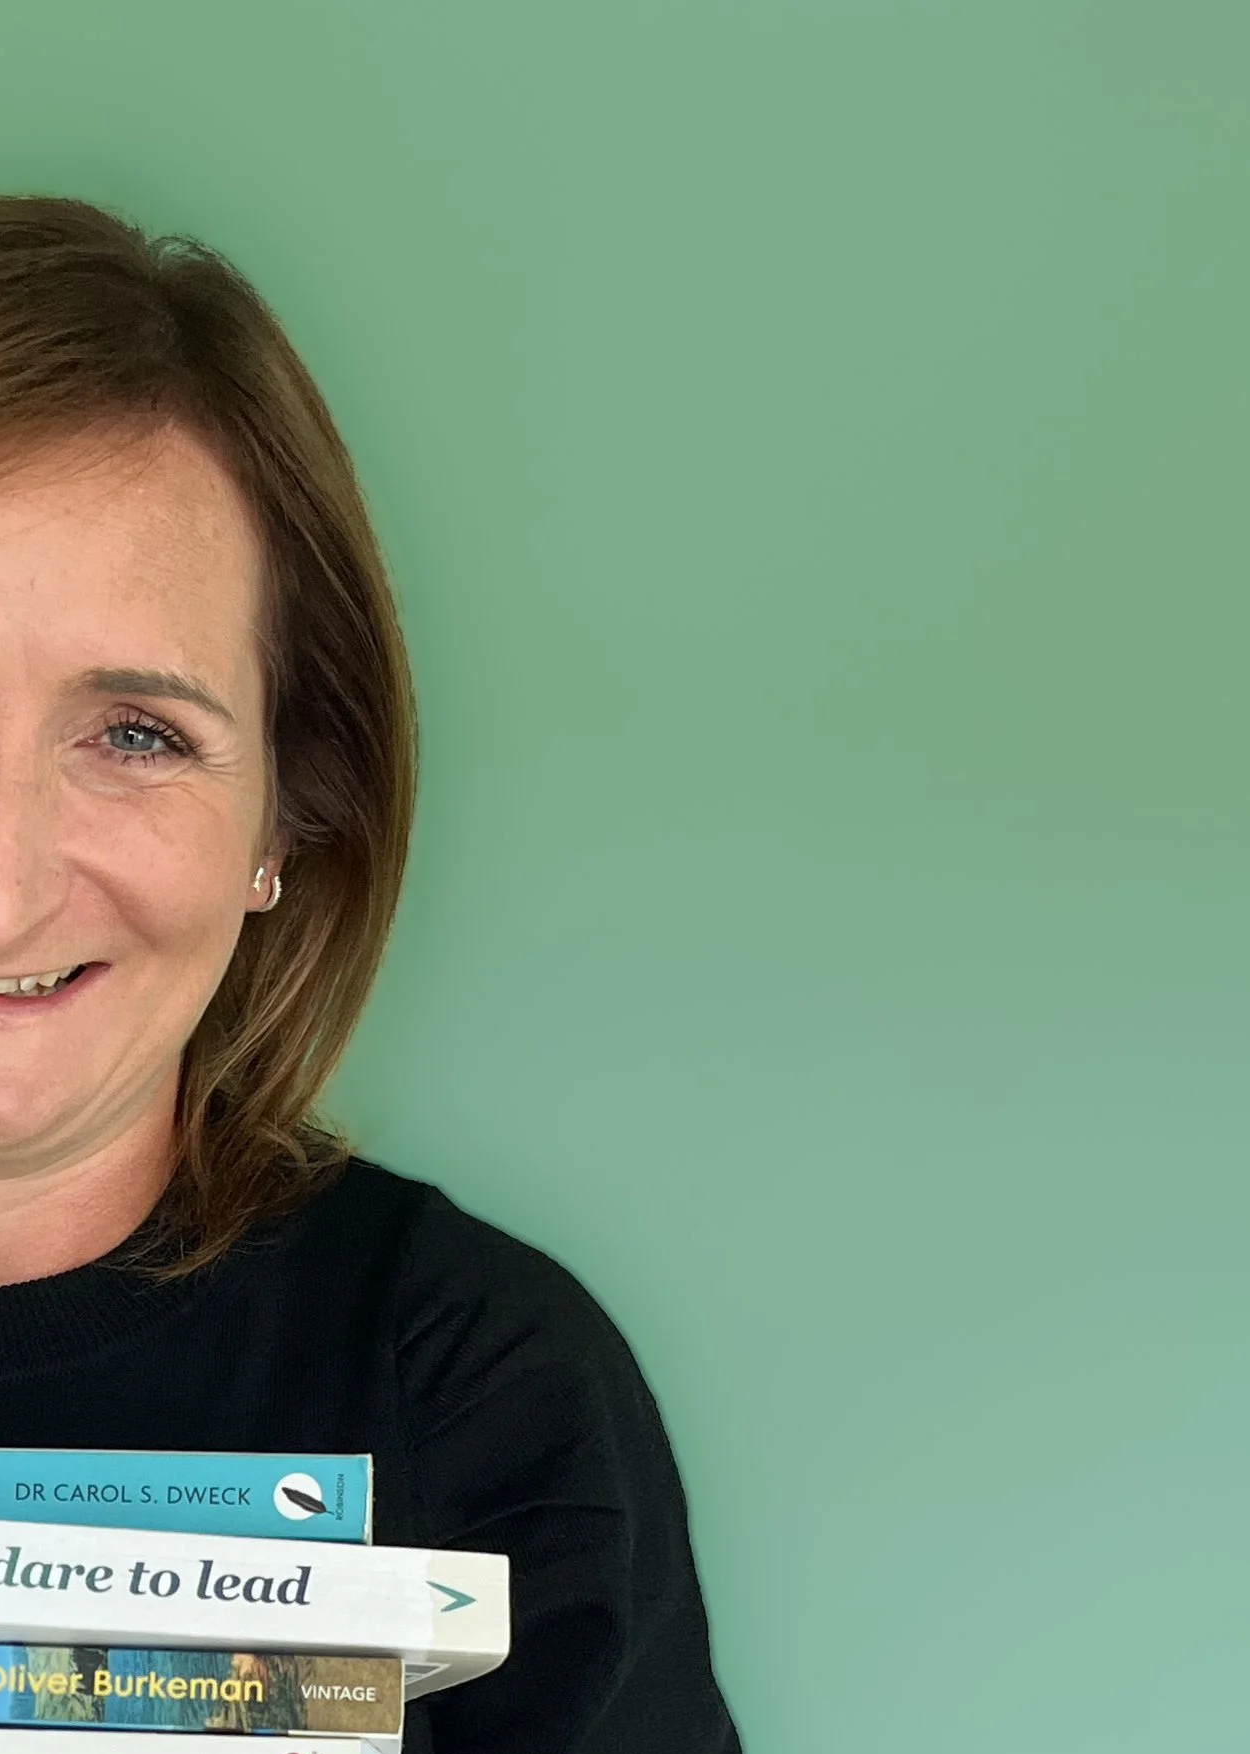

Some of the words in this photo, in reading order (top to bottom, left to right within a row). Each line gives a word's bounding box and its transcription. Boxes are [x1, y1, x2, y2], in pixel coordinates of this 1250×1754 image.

[15, 1482, 46, 1502] DR
[54, 1483, 132, 1504] CAROL
[140, 1485, 158, 1505] S.
[167, 1485, 251, 1507] DWECK
[334, 1473, 345, 1521] ROBINSON
[128, 1561, 181, 1597] to
[197, 1560, 313, 1606] lead
[92, 1669, 265, 1702] Burkeman
[301, 1684, 376, 1702] VINTAGE
